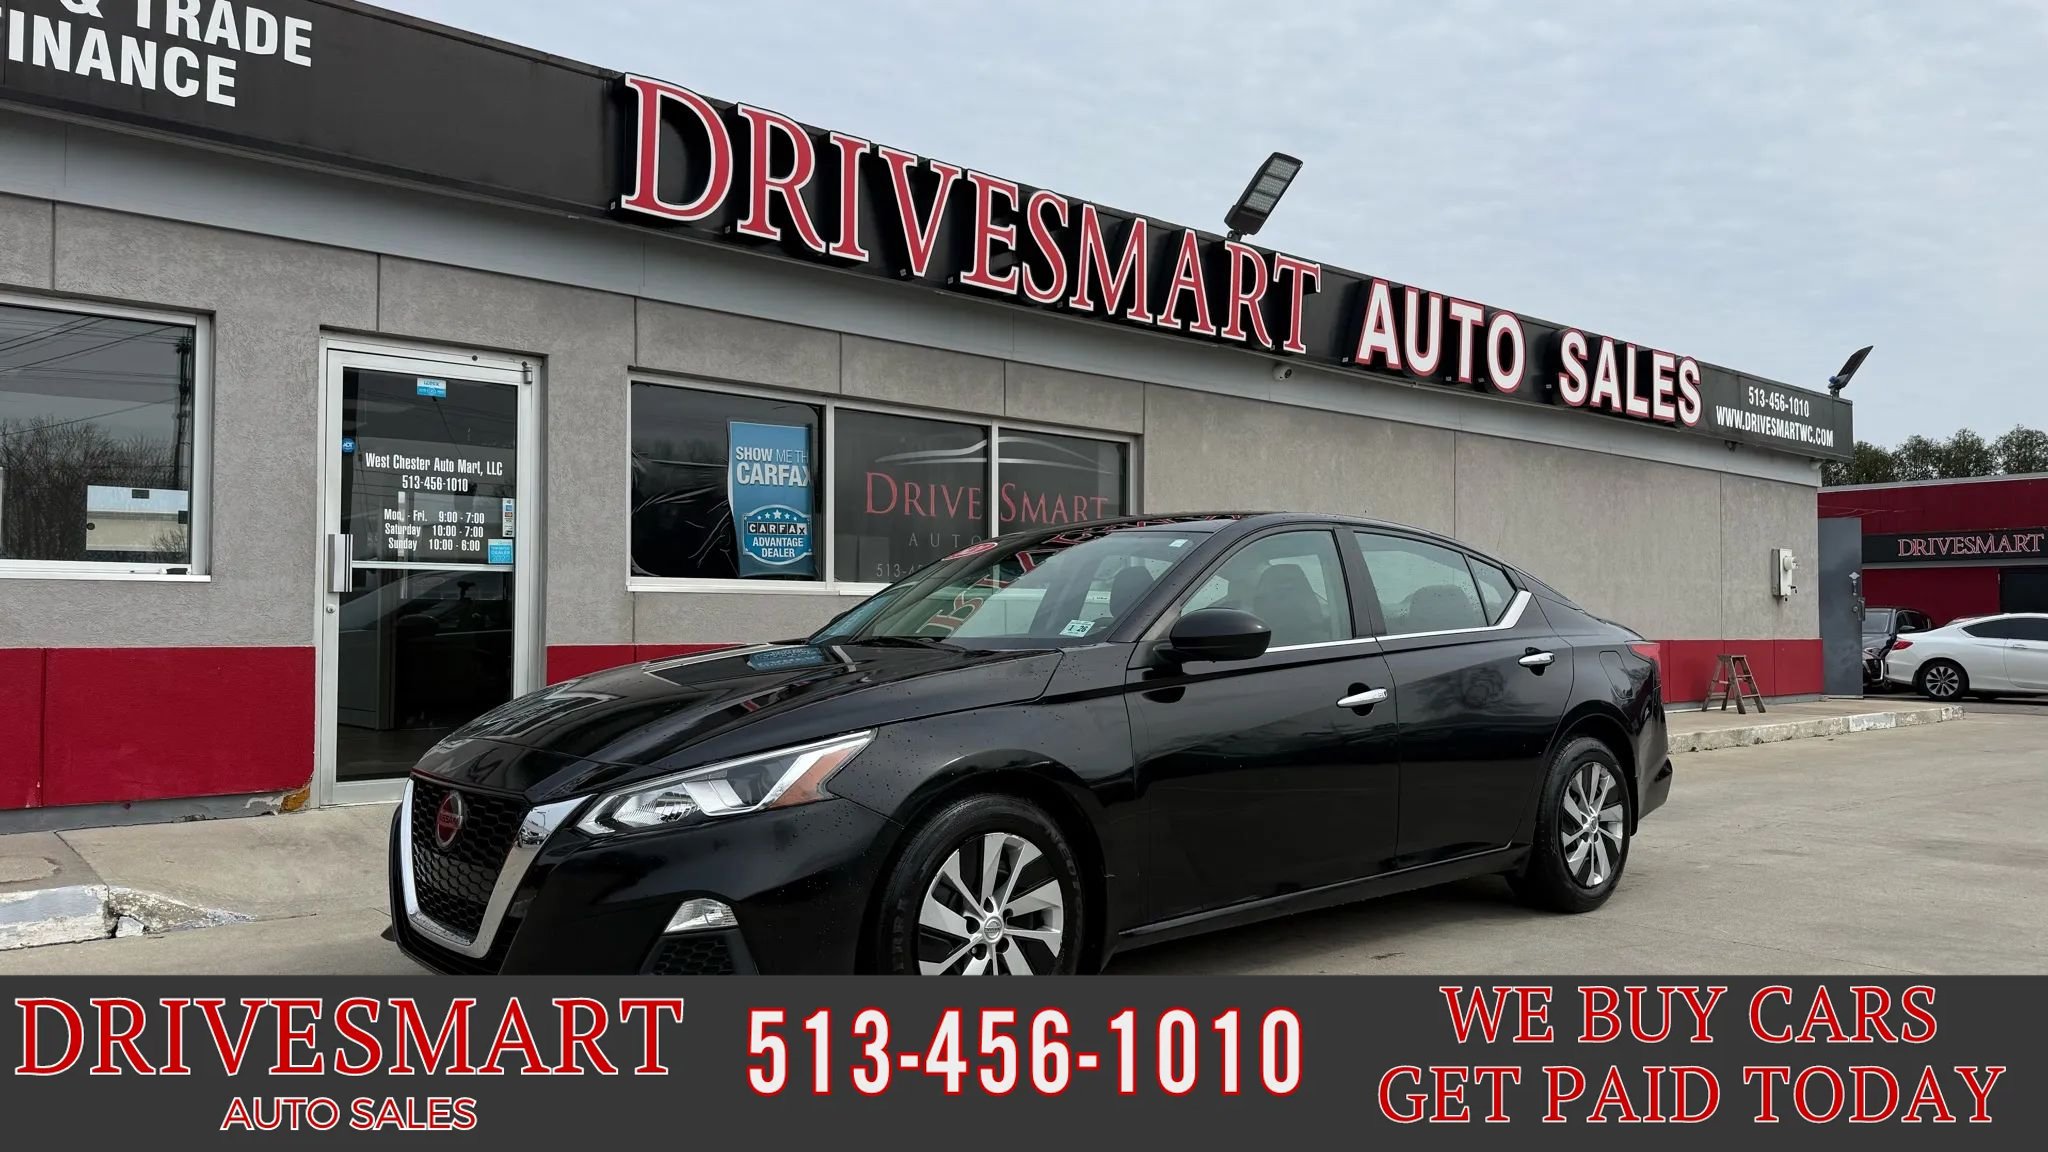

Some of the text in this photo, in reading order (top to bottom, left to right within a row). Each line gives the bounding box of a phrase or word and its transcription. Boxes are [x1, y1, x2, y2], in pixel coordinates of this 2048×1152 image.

[0, 8, 237, 107] INANCE
[620, 72, 1322, 354] DRIVESMART
[1354, 277, 1703, 428] AUTO SALES
[1748, 386, 1810, 418] 513-456-1010
[1716, 405, 1834, 448] WWW.DRIVESMARTWC.COM
[365, 452, 503, 476] West Chester Auto Mart, LLC
[735, 446, 773, 462] SHOW
[776, 449, 793, 463] ME
[402, 474, 469, 492] 513-456-1010
[864, 471, 1110, 525] DRIVE SMART
[384, 508, 405, 521] Mon.
[413, 510, 428, 522] Fri.
[438, 511, 458, 523] 9:00
[465, 512, 485, 524] 7:00
[385, 523, 421, 537] Saturday
[432, 525, 457, 537] 10:00
[464, 526, 484, 538] 7:00
[748, 522, 807, 535] CARFAX
[388, 537, 418, 551] Sunday
[429, 539, 453, 551] 10:00
[461, 539, 481, 551] 6:00
[752, 537, 804, 547] ADVANTAGE
[761, 547, 796, 558] DEALER
[1898, 532, 2045, 557] DRIVESMART
